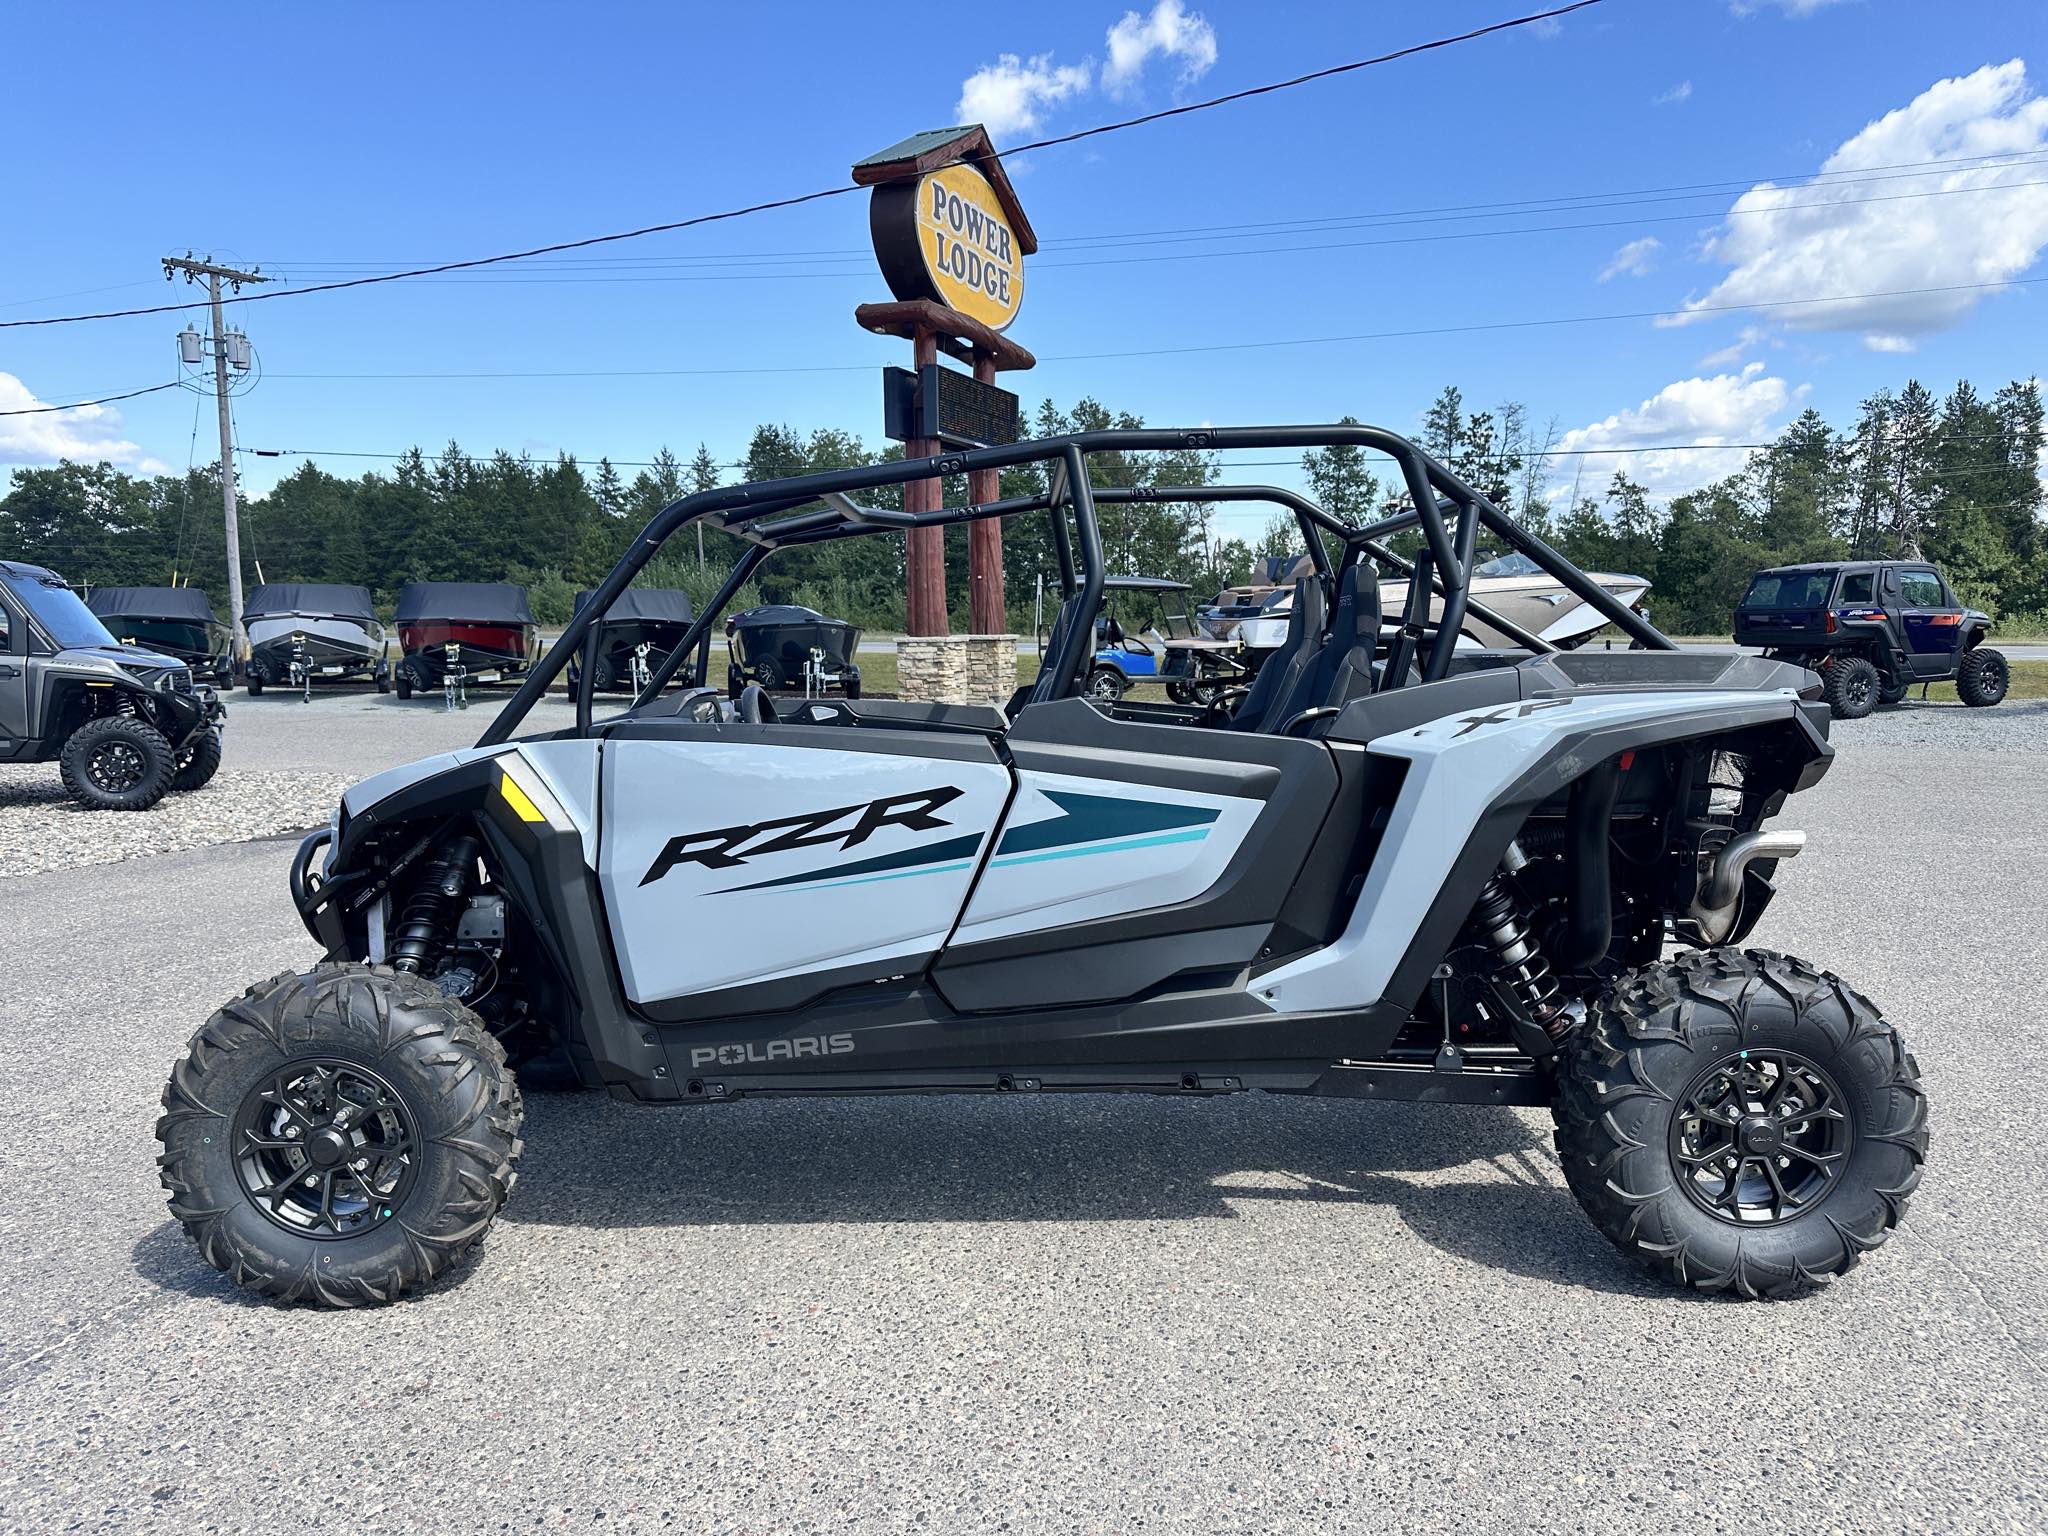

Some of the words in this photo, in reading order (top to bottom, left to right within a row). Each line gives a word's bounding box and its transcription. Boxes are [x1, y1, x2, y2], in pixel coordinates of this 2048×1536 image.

[932, 181, 1013, 265] POWER
[936, 232, 1010, 304] LODGE
[1450, 698, 1574, 739] XP
[637, 785, 966, 888] RZR
[690, 1033, 856, 1068] POLARIS
